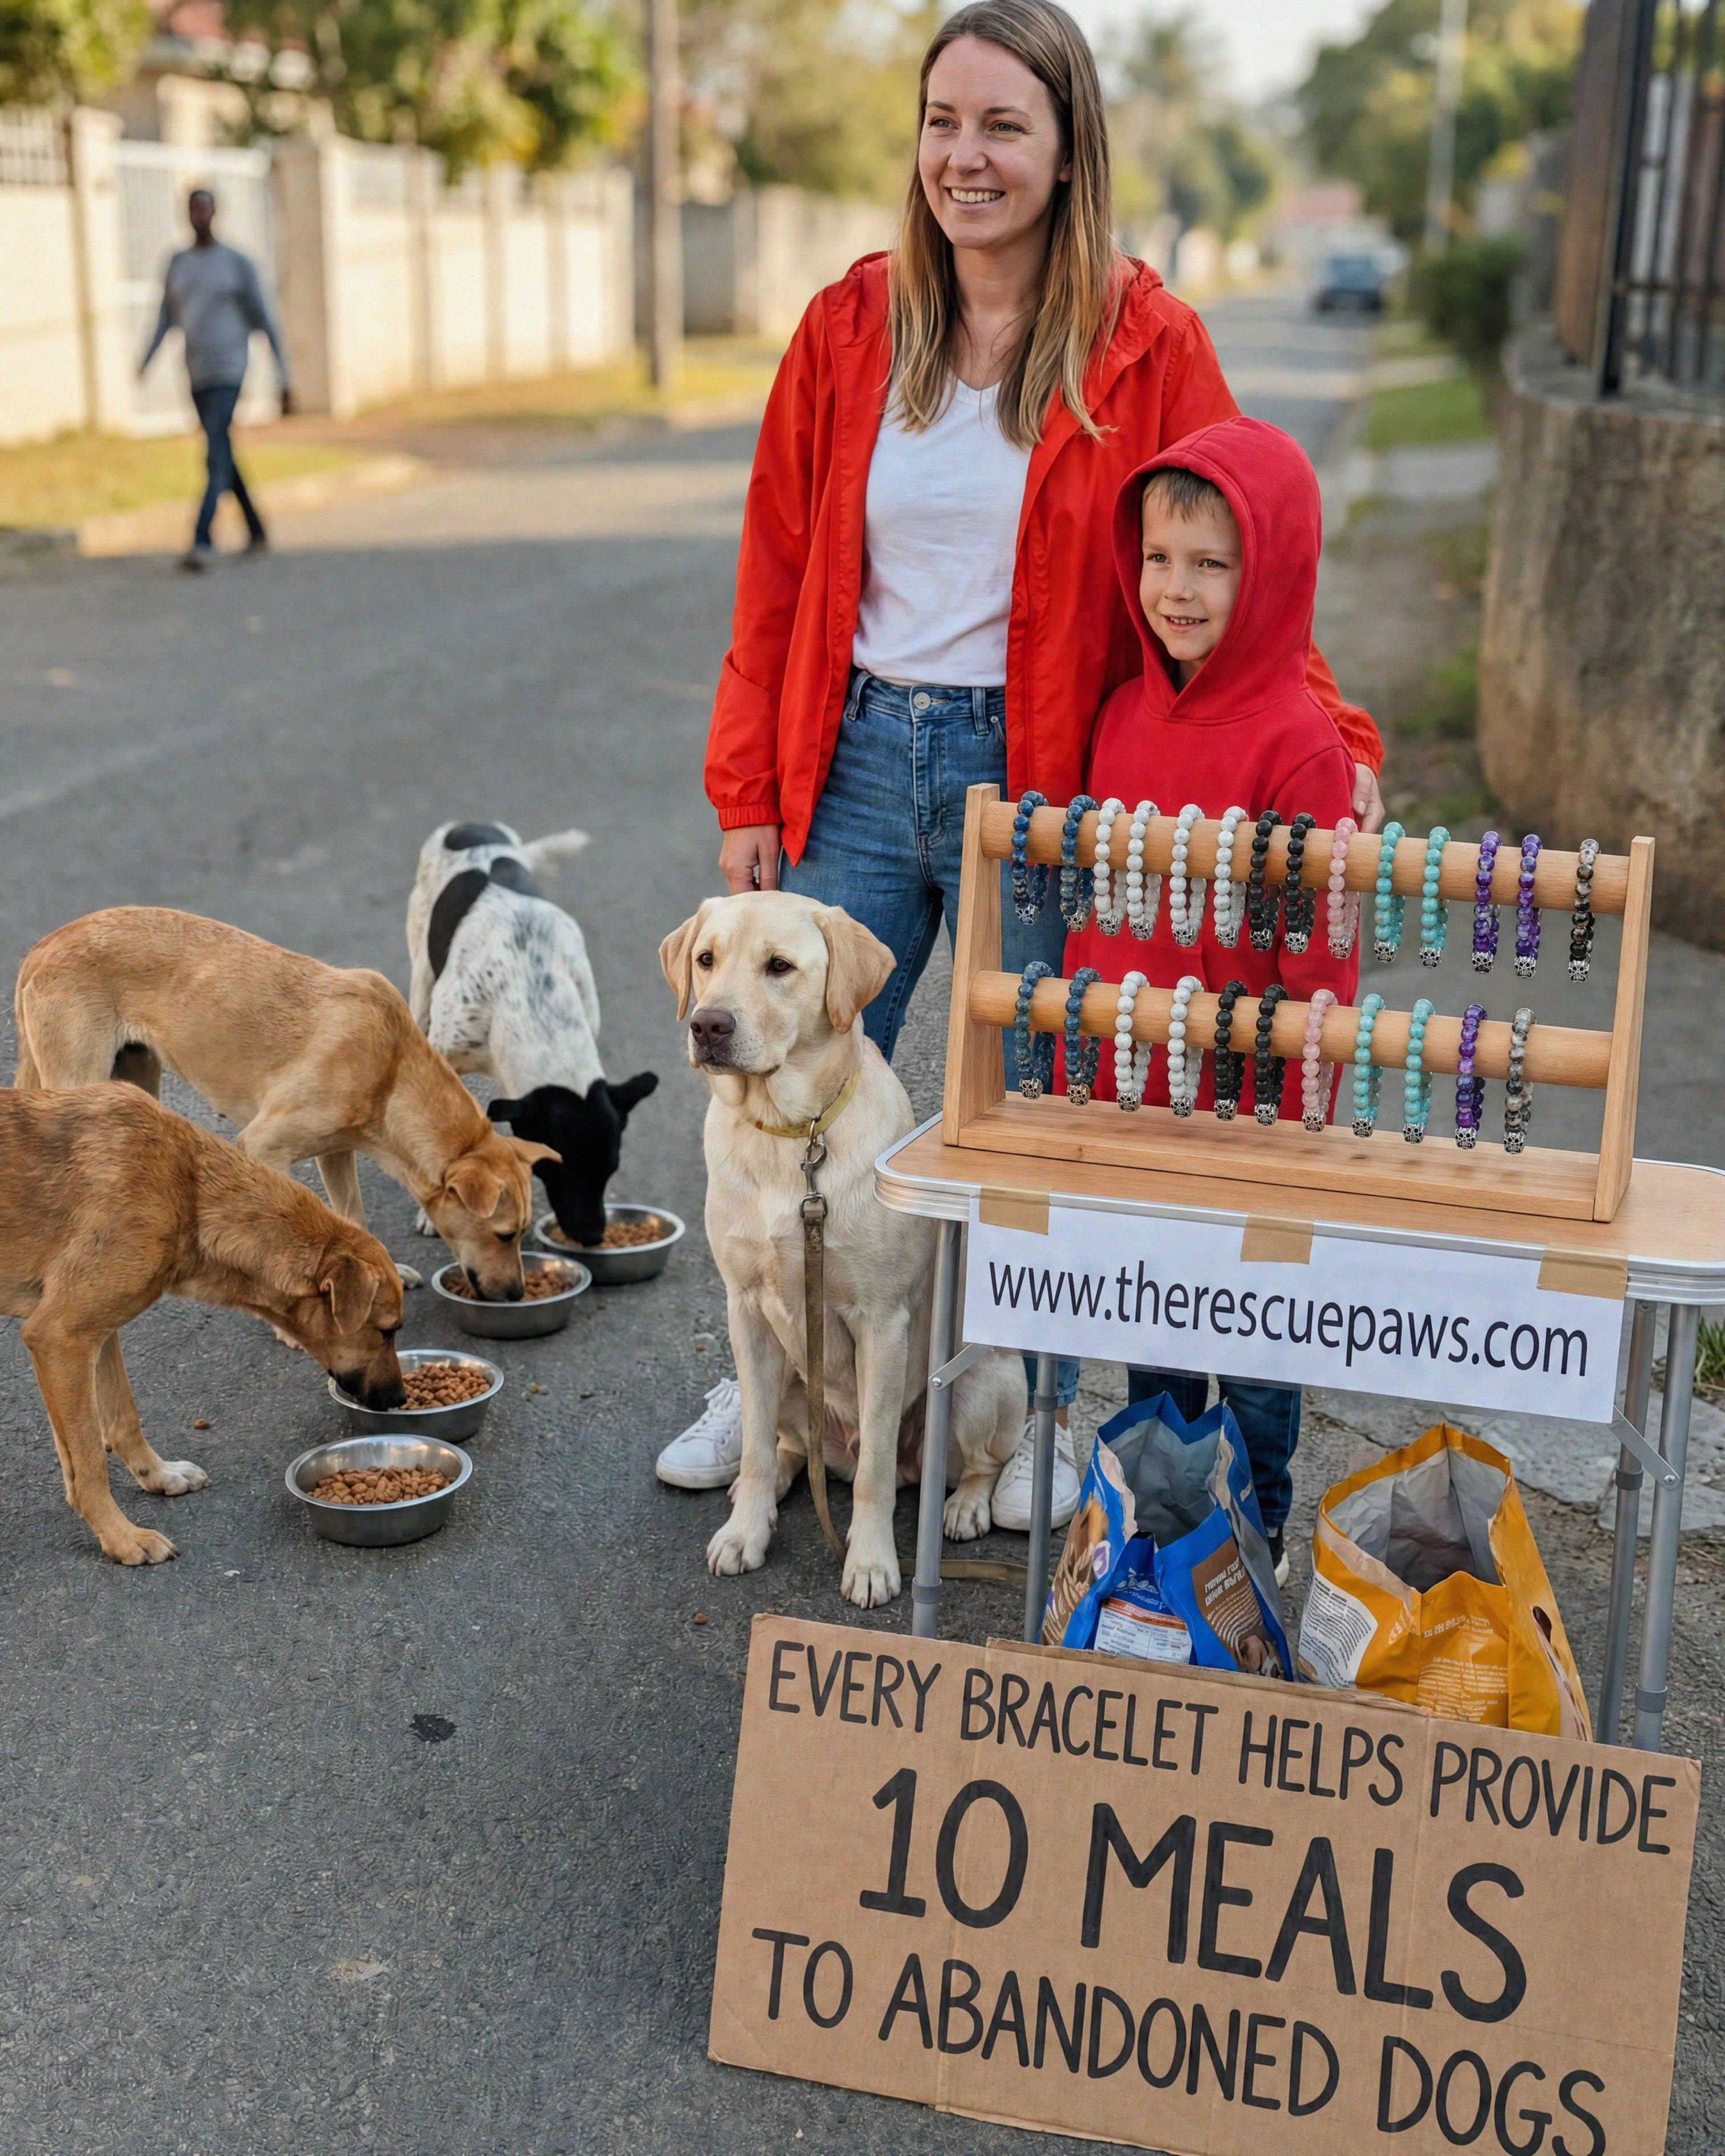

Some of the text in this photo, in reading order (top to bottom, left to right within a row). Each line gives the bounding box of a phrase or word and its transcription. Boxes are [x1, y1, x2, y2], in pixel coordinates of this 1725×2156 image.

[989, 1260, 1588, 1377] www.therescuepaws.com
[768, 1640, 1678, 1856] EVERY BRACELET HELPS PROVIDE
[859, 1767, 1528, 2024] 10 MEALS
[751, 1927, 1607, 2156] TO ABANDONED DOGS
